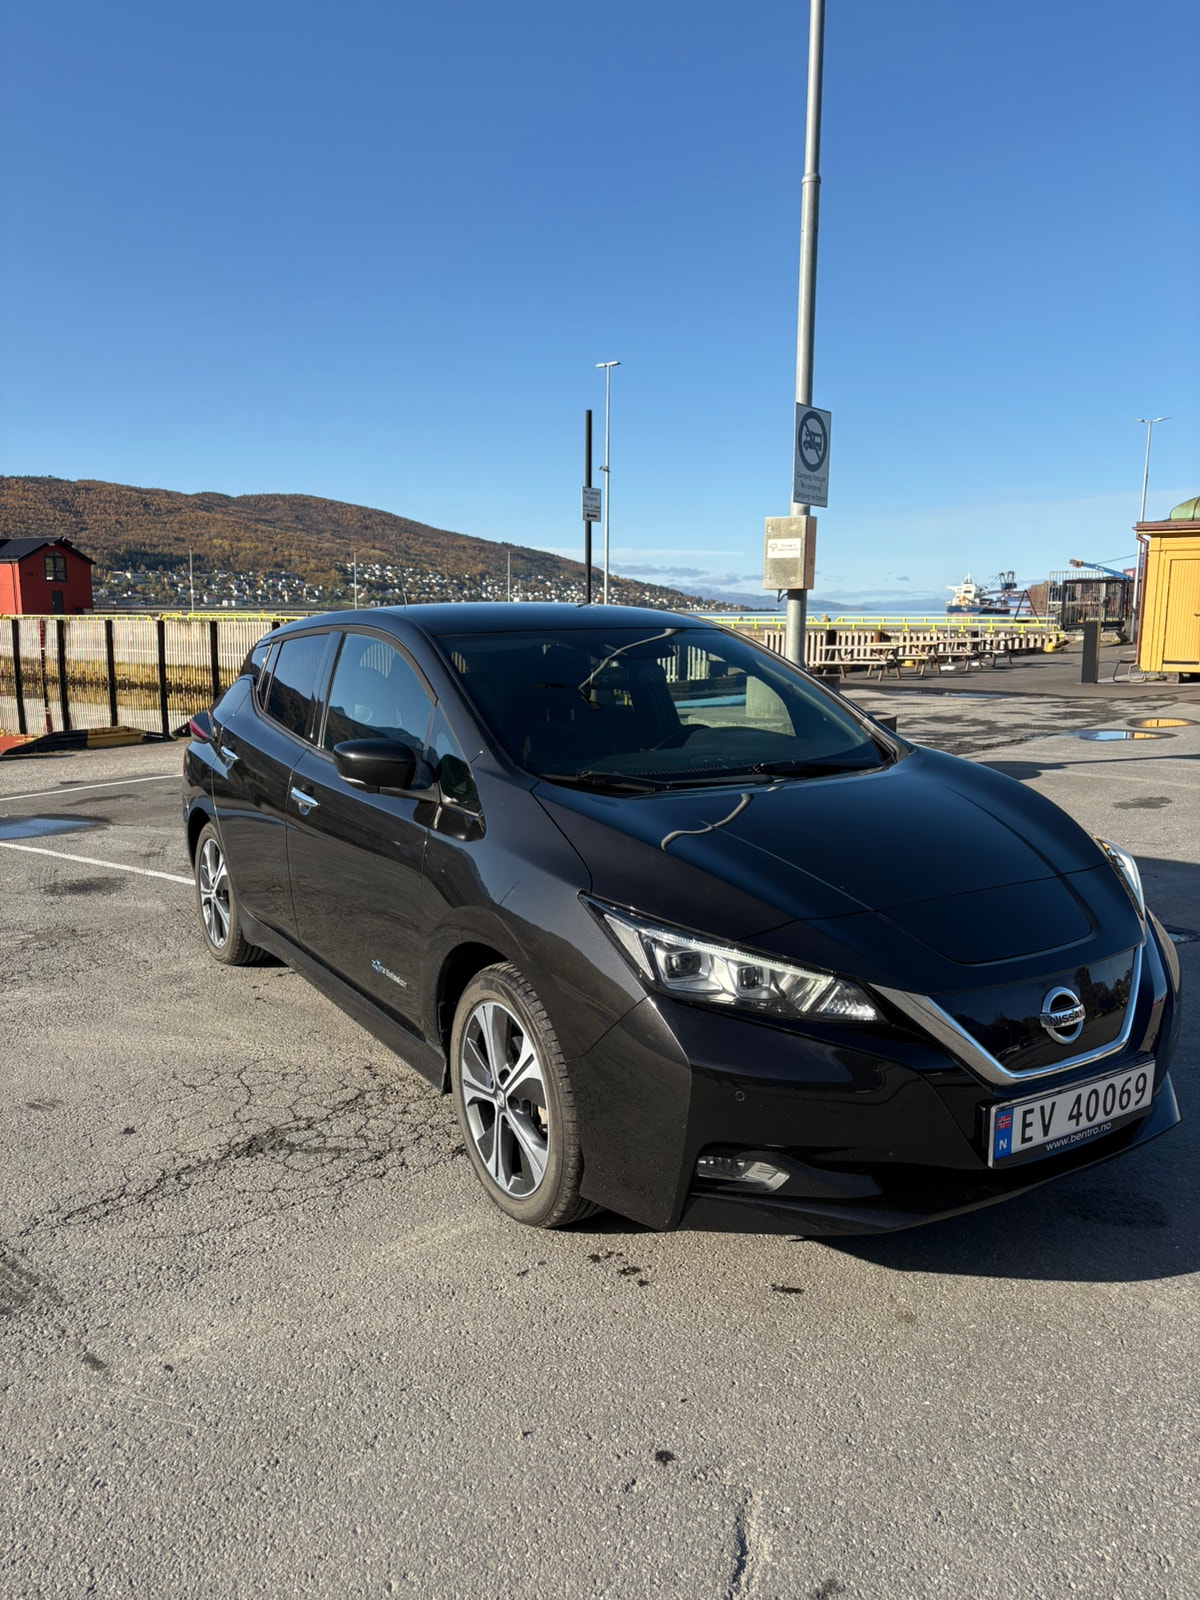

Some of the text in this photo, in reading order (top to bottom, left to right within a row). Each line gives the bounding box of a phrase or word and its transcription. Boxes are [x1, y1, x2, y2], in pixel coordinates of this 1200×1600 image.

[1050, 1009, 1085, 1026] NISSAN
[1020, 1072, 1147, 1145] EV 40069
[999, 1138, 1007, 1150] N
[1045, 1121, 1112, 1150] www.bentro.no
